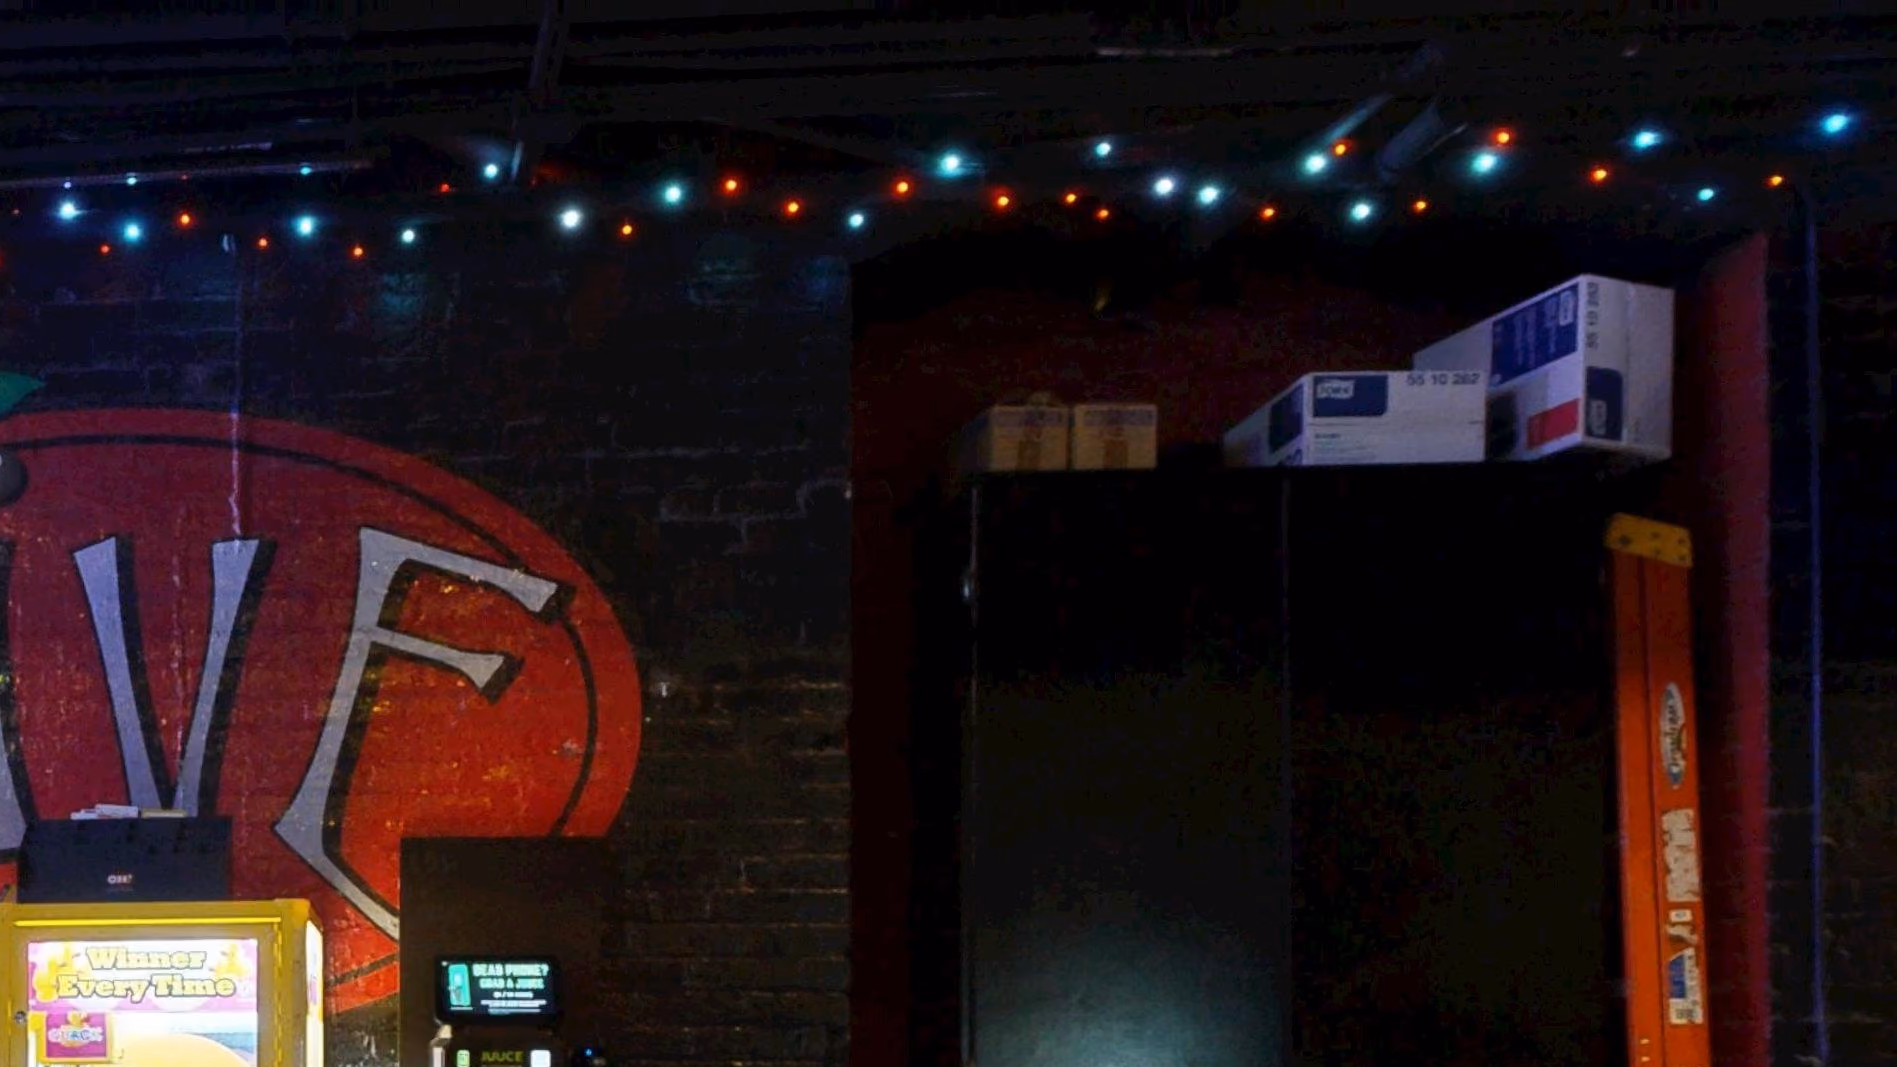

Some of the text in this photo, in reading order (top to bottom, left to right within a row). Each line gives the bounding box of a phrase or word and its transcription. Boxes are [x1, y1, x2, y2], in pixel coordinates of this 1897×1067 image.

[86, 945, 207, 970] Winner
[56, 973, 237, 1004] Every Time
